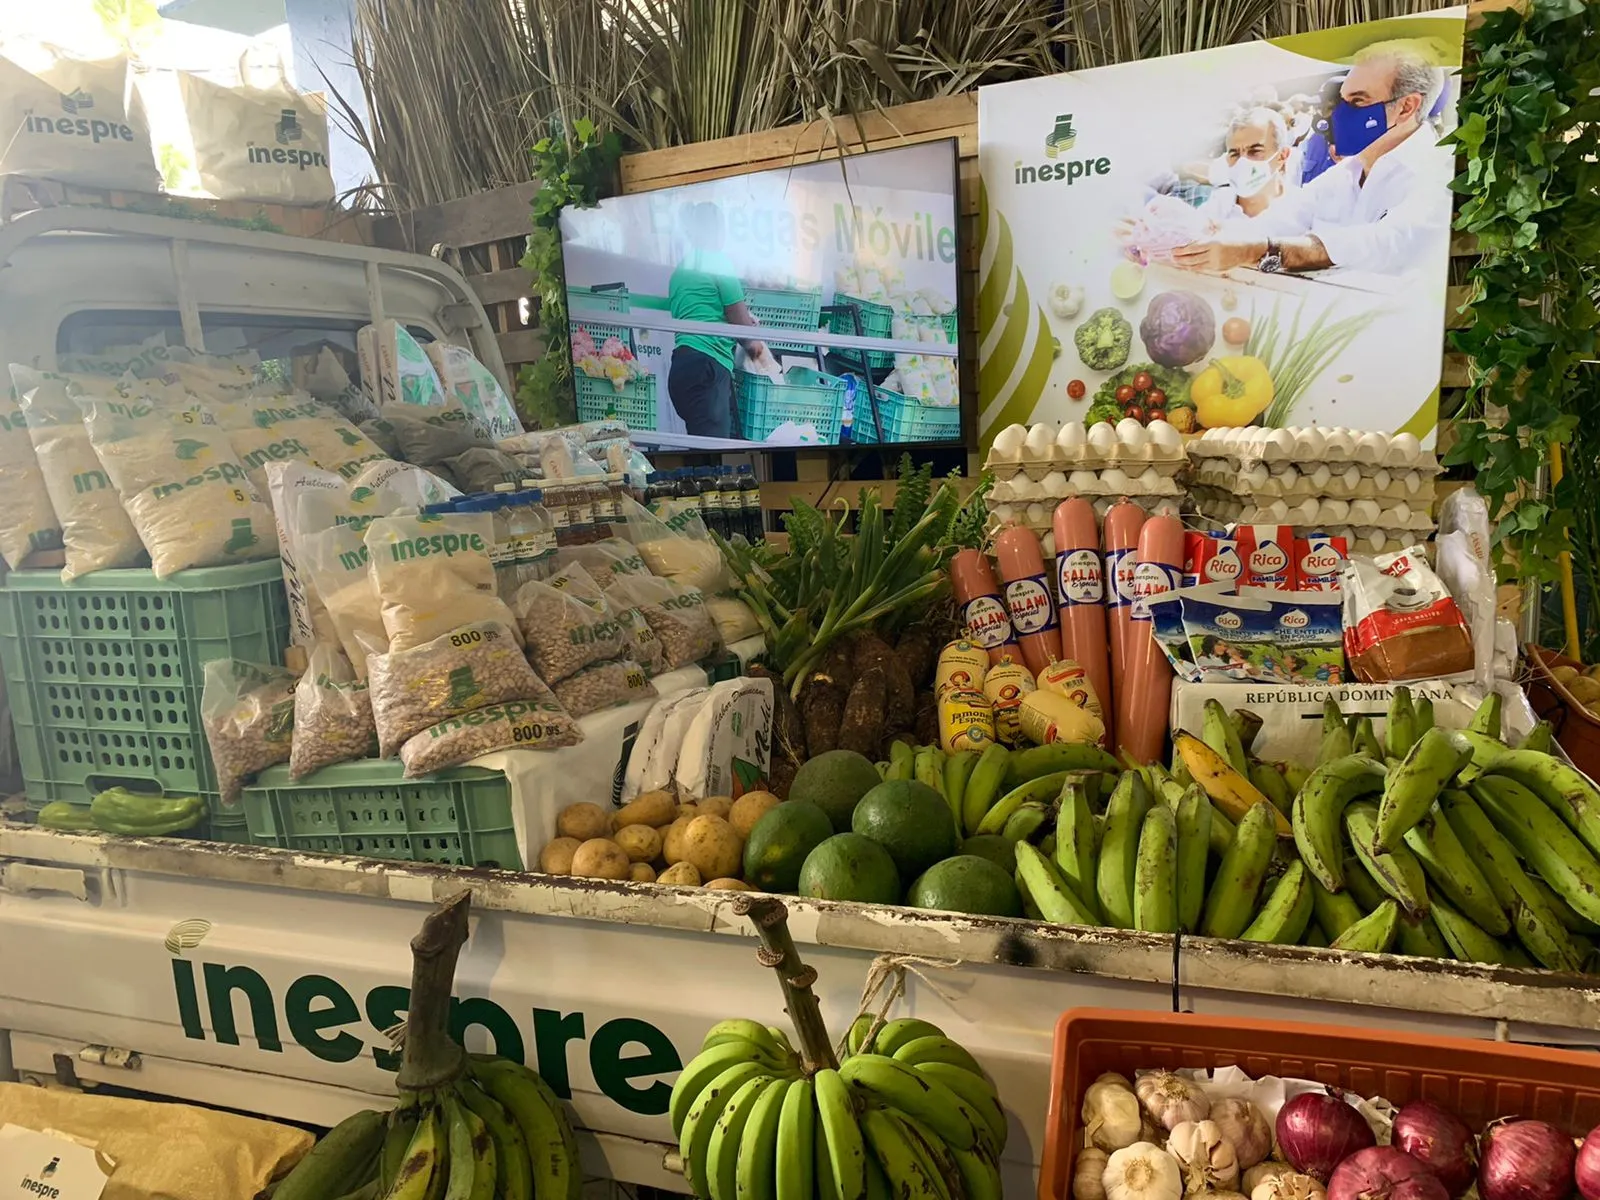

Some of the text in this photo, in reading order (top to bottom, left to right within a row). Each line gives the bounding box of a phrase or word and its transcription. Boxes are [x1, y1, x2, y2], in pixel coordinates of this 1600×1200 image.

[25, 108, 134, 143] inespre
[1014, 156, 1111, 185] inespre
[182, 412, 194, 424] 5
[233, 489, 244, 502] 5
[391, 531, 485, 562] inespre
[1210, 559, 1237, 574] Rica
[1252, 553, 1282, 567] Rica
[1307, 555, 1336, 568] Rica
[1218, 616, 1239, 626] Rica
[1283, 615, 1305, 625] Rica
[450, 630, 481, 649] 800
[1246, 689, 1453, 704] REPÚBLICA DOMINCANA
[429, 700, 562, 738] inespre
[513, 723, 543, 742] 800
[172, 956, 684, 1116] inespre
[20, 1175, 60, 1200] inespre
